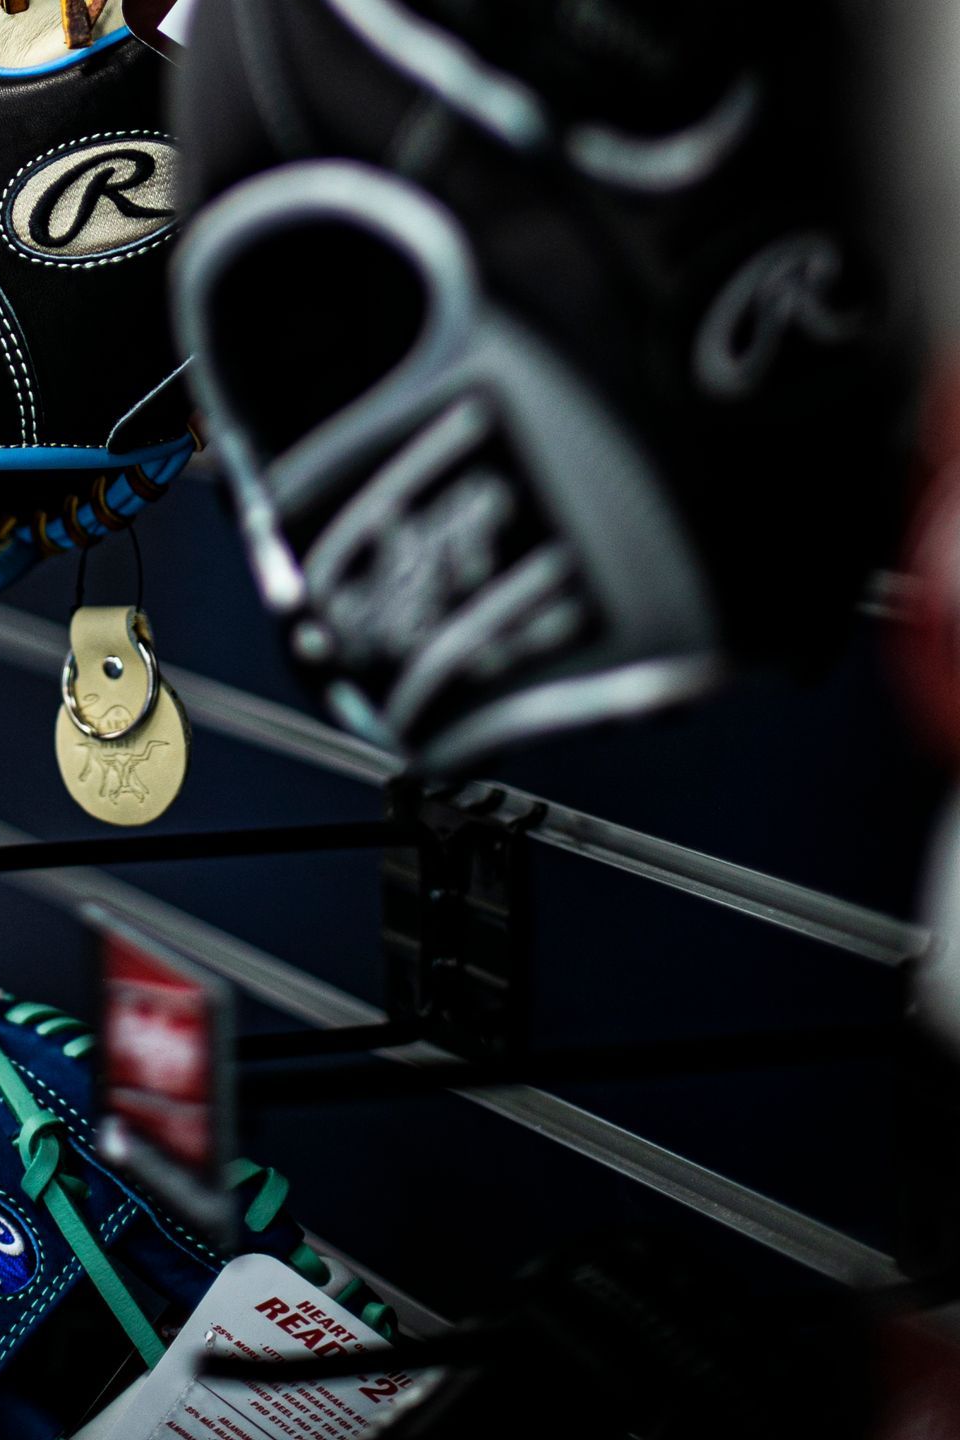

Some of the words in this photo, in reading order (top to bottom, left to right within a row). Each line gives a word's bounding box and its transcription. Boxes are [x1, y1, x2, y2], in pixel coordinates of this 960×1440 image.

[295, 1300, 358, 1343] HEART
[212, 1324, 234, 1342] 25%
[233, 1340, 261, 1360] MORE
[296, 1387, 337, 1418] BREAK-IN
[335, 1416, 353, 1431] FOR
[184, 1405, 201, 1419] 25%
[250, 1400, 271, 1416] PRO
[268, 1414, 297, 1436] STYLE
[271, 1400, 294, 1419] HEEL
[293, 1417, 312, 1432] PAD
[282, 1392, 312, 1414] HEART
[309, 1413, 324, 1424] OF
[321, 1422, 340, 1437] THE
[315, 1385, 356, 1417] BREAK-IN
